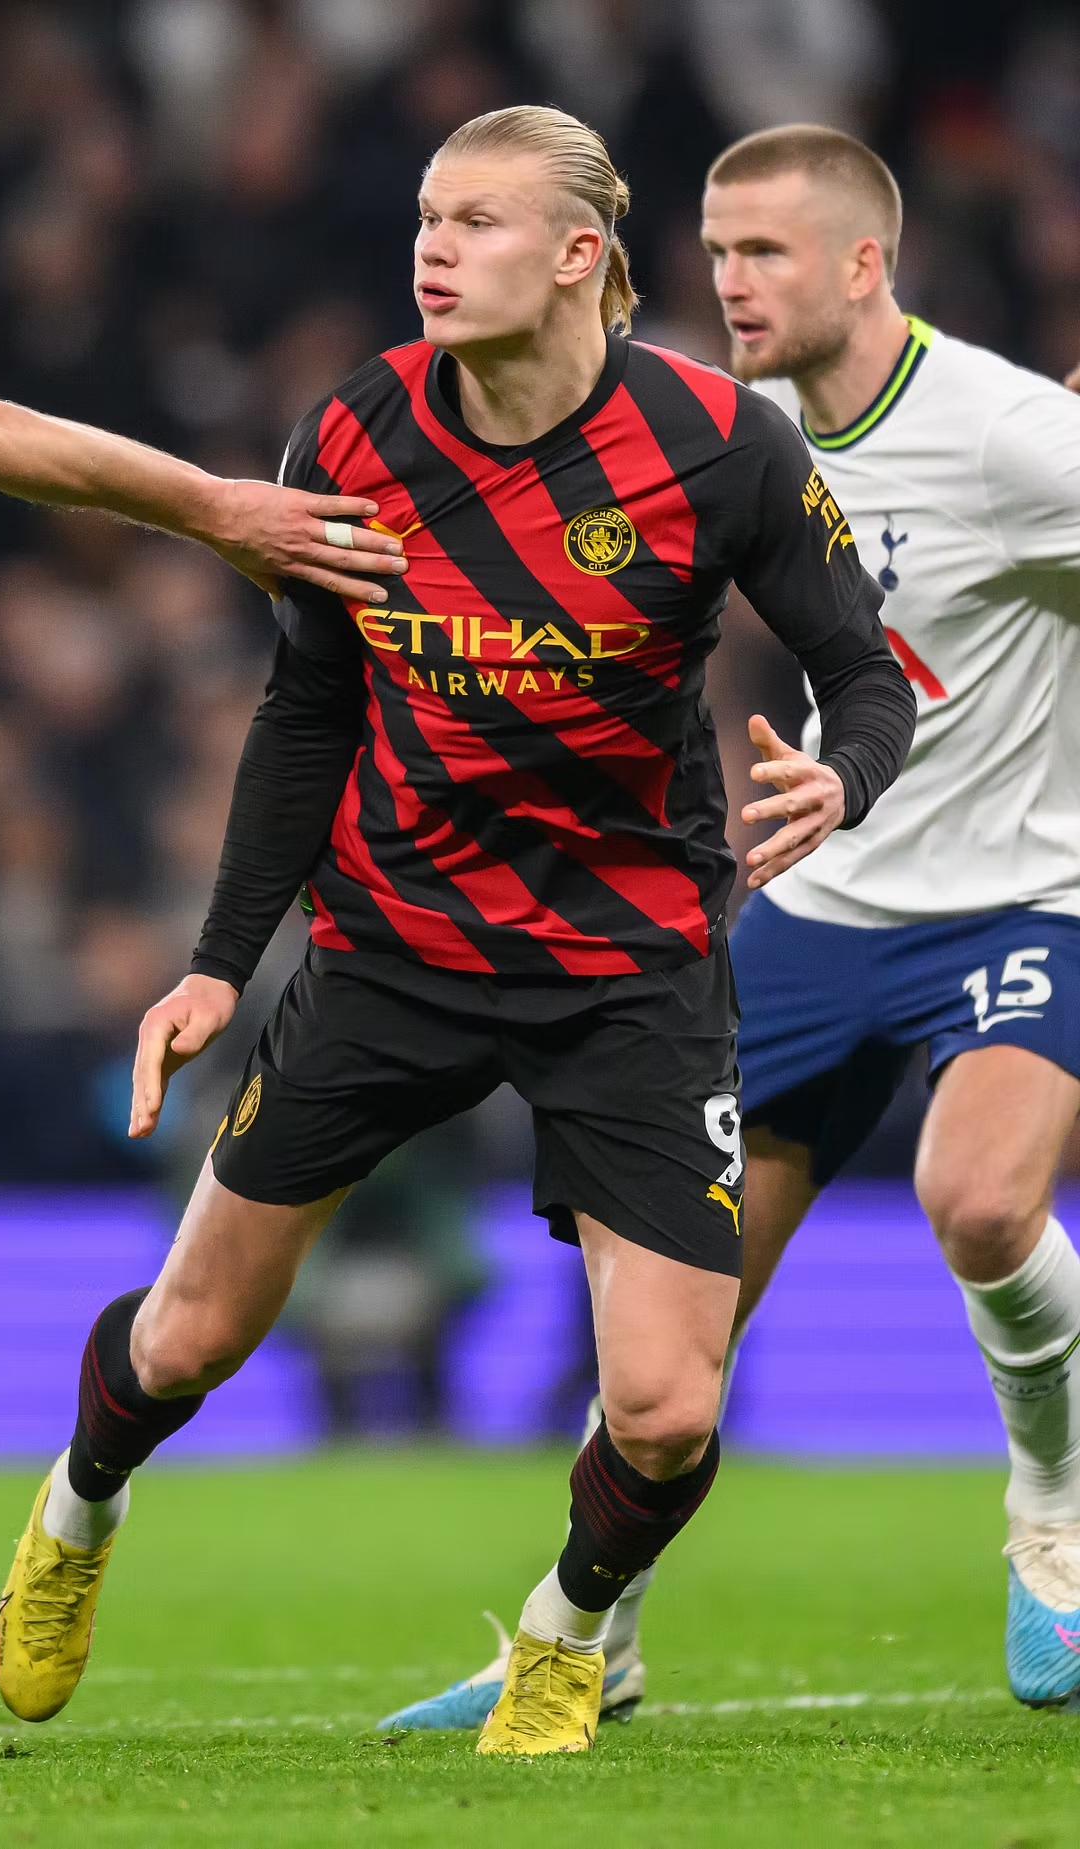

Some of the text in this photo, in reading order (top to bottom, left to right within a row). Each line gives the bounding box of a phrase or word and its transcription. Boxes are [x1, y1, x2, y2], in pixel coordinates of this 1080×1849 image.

[573, 510, 629, 534] MANCHESTER
[588, 562, 610, 570] CITY
[356, 608, 650, 660] ETIHAD
[408, 664, 595, 696] AIRWAYS
[962, 946, 1053, 1016] 15
[703, 1093, 743, 1186] 9
